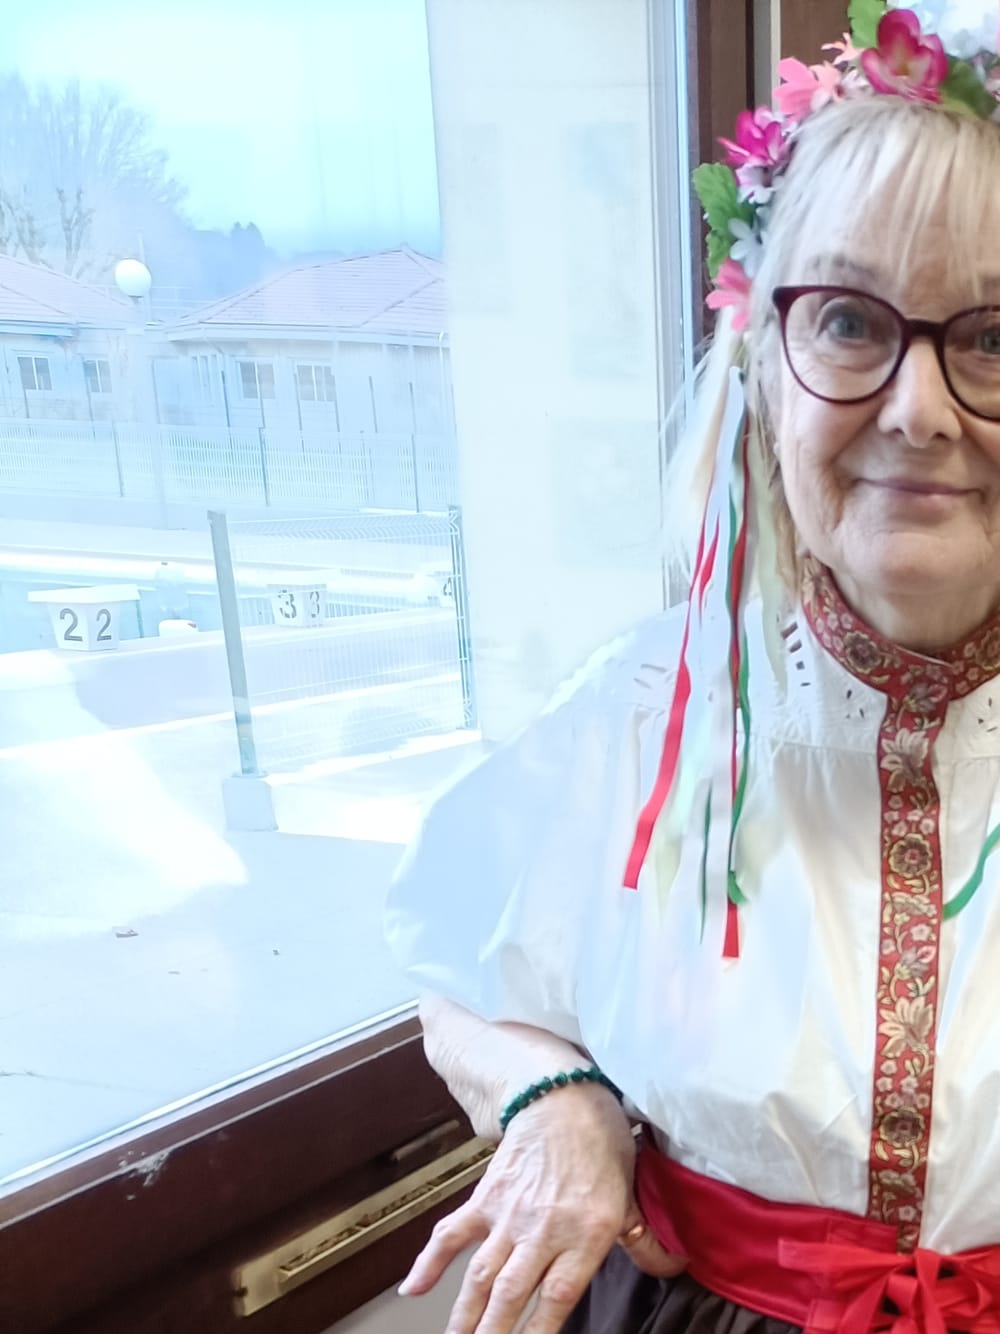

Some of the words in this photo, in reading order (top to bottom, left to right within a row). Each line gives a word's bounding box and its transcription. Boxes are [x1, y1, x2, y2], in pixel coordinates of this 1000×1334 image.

[278, 590, 297, 618] 3
[60, 608, 83, 641] 2
[96, 609, 112, 641] 2
